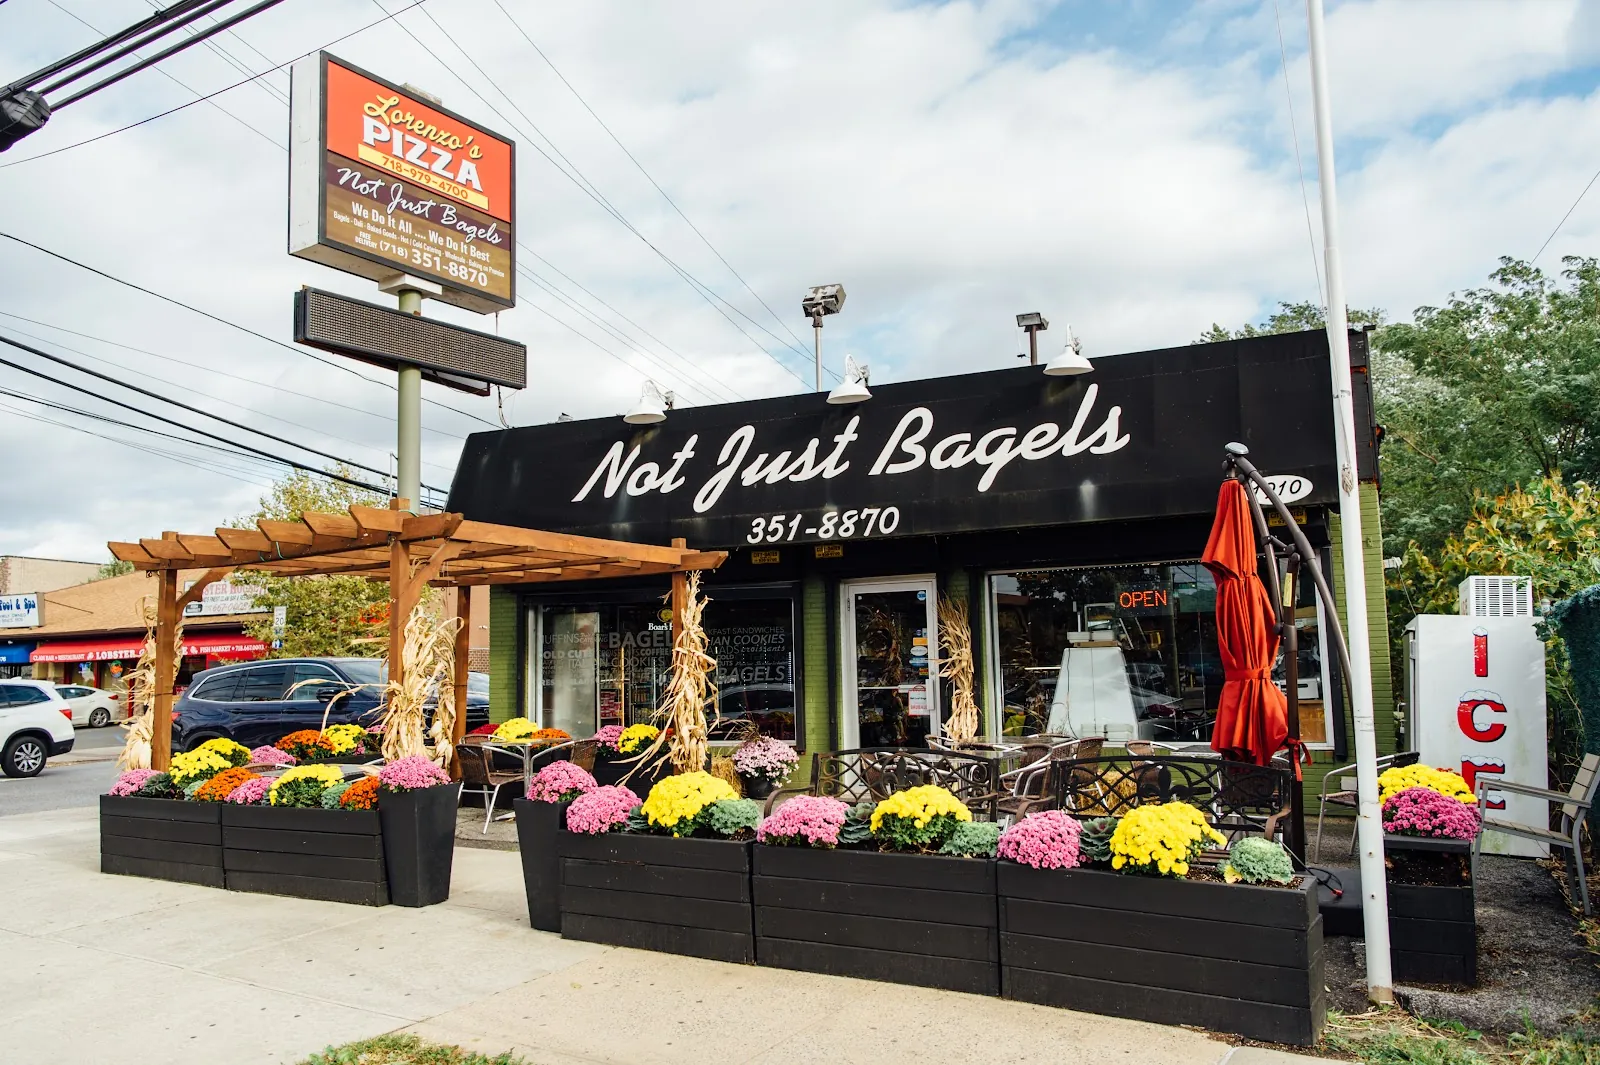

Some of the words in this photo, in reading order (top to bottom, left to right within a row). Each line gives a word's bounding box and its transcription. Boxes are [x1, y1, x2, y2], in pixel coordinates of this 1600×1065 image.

[363, 95, 483, 159] Lorenzo's
[362, 114, 483, 193] PIZZA
[382, 156, 468, 200] 718-979-4700
[337, 168, 385, 198] Not
[386, 184, 437, 218] Just
[440, 204, 502, 244] Bagels
[333, 211, 350, 223] Bagels
[366, 223, 381, 234] Baked
[352, 201, 368, 218] We
[371, 209, 385, 224] Do
[388, 215, 396, 229] It
[399, 219, 412, 234] All
[428, 230, 443, 246] We
[446, 236, 458, 251] Do
[461, 242, 468, 254] It
[470, 245, 490, 262] Best
[359, 231, 371, 240] FREE
[355, 235, 377, 249] DELIVERY
[379, 240, 408, 259] (718)
[411, 249, 488, 286] 351-8870
[571, 434, 699, 503] Not
[692, 415, 860, 513] Just
[868, 384, 1131, 493] Bagels
[747, 506, 900, 545] 351-8870
[203, 583, 227, 595] STER
[24, 597, 36, 614] Spa
[1119, 590, 1168, 607] OPEN
[541, 631, 579, 646] UFFINS
[732, 626, 785, 634] SANDWICHES
[609, 631, 673, 649] BAGEL
[733, 633, 786, 645] COOKIES
[96, 649, 135, 660] LOBSTER
[542, 651, 565, 660] OLD
[717, 665, 786, 682] BAGELS
